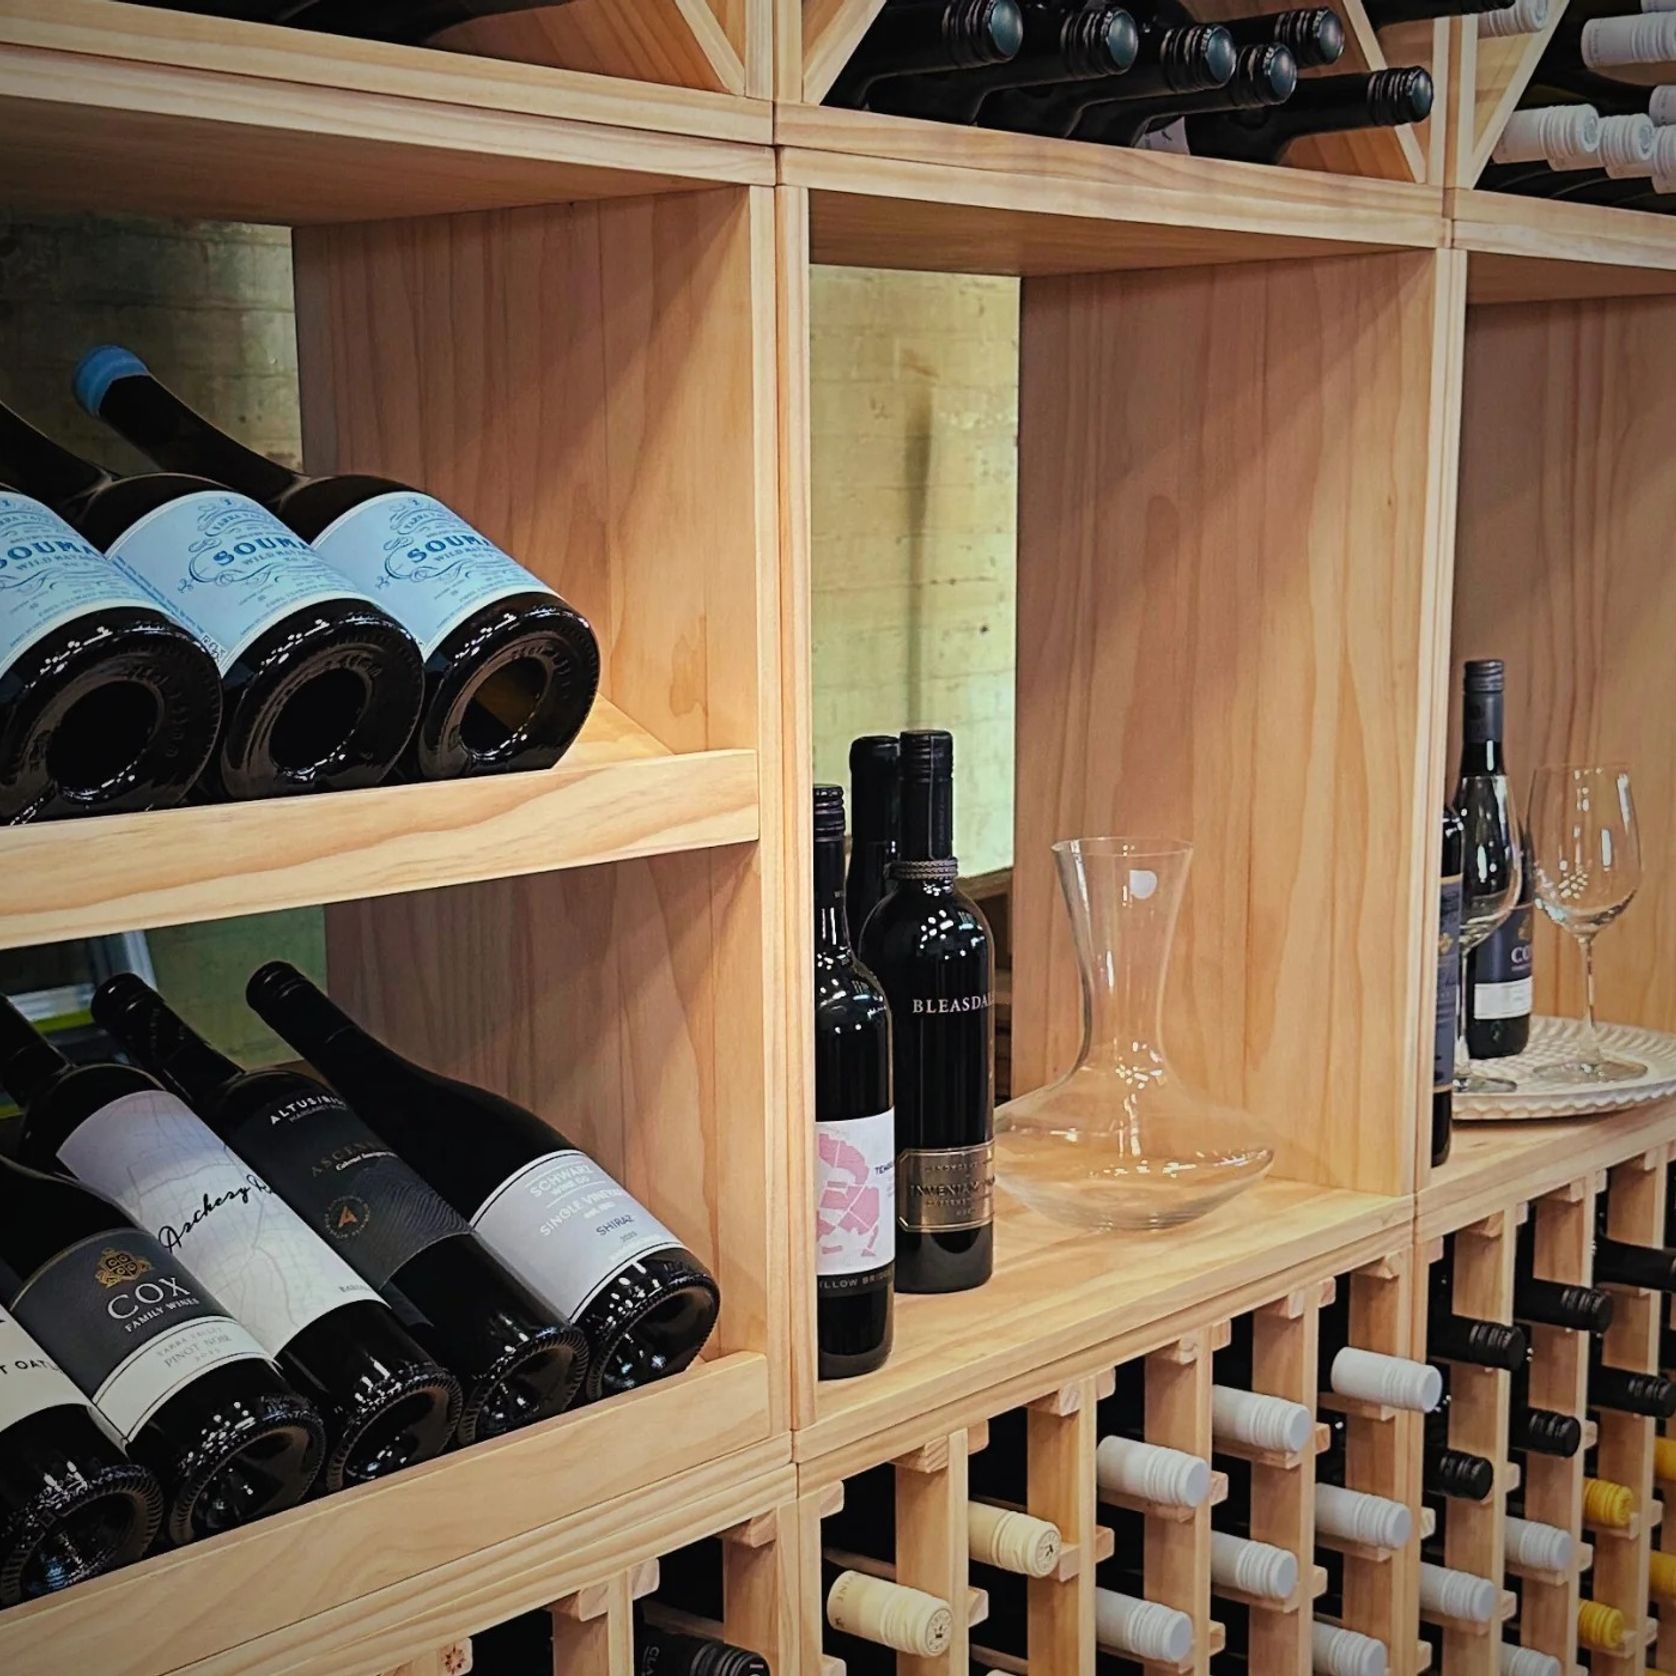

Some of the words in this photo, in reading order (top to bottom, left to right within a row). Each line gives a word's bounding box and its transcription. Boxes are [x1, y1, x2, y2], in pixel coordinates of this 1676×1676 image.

[540, 1198, 583, 1236] SINGLE
[596, 1214, 635, 1236] SHIRAZ
[107, 1277, 191, 1320] COX
[124, 1306, 164, 1333] FAMILY
[164, 1343, 200, 1368] PINOT
